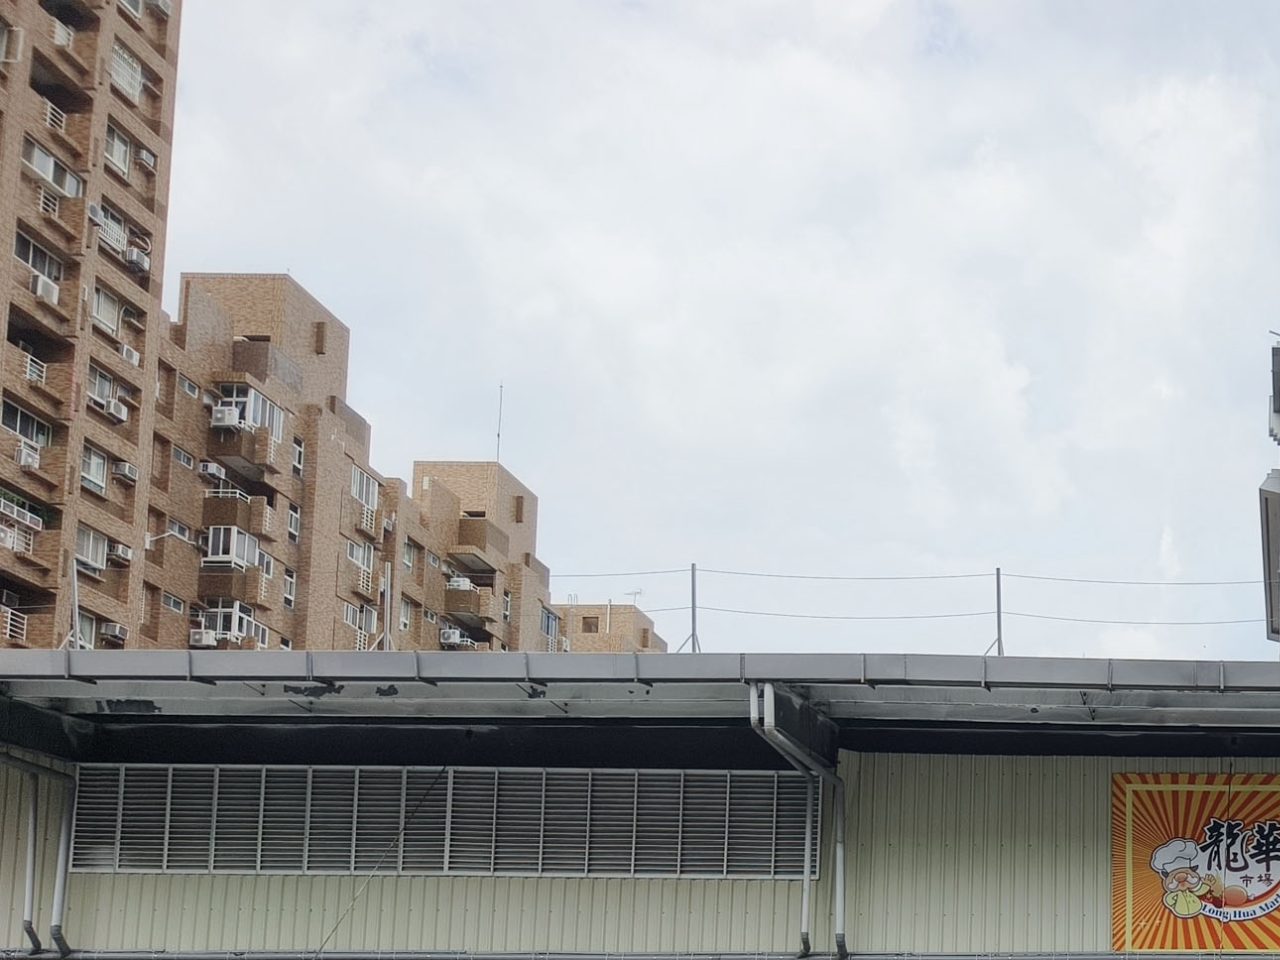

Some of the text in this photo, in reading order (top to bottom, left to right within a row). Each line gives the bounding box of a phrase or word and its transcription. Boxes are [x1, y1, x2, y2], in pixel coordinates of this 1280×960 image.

[1240, 874, 1274, 887] 市場
[1202, 904, 1229, 920] Long
[1232, 908, 1257, 919] Hua
